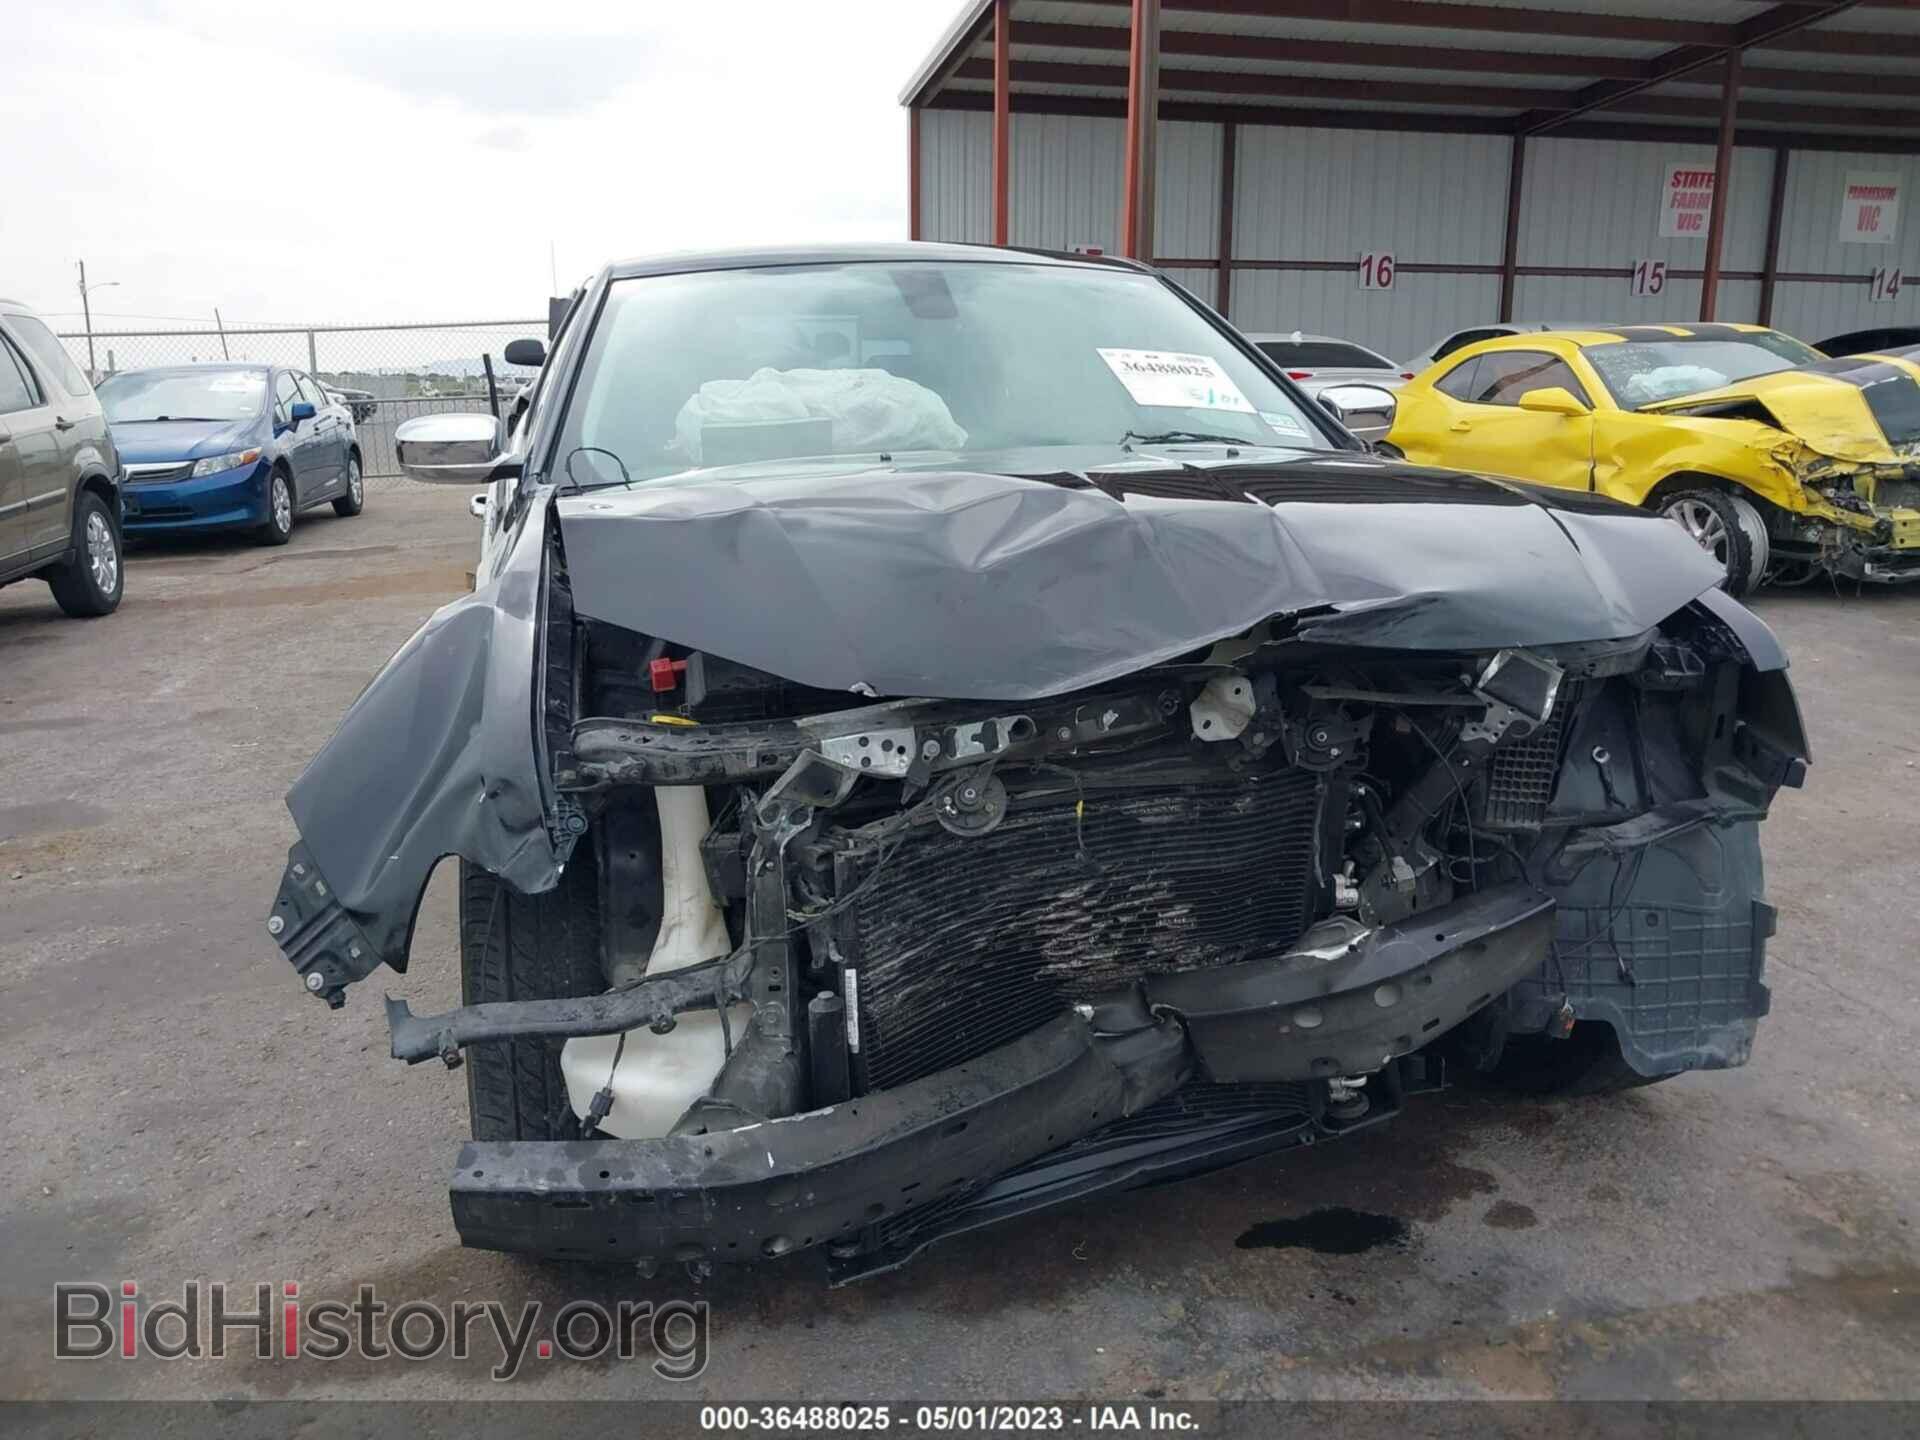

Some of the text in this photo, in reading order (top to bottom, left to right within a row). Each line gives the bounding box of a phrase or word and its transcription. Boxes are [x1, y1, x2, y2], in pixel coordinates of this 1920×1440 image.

[1671, 171, 1715, 188] STATE
[1670, 191, 1712, 208] FARM
[1678, 213, 1703, 230] VIC
[1857, 205, 1881, 232] VIC
[1360, 255, 1393, 288] 16
[1637, 261, 1665, 295] 15
[1875, 268, 1900, 300] 14
[1121, 361, 1215, 378] 36488025
